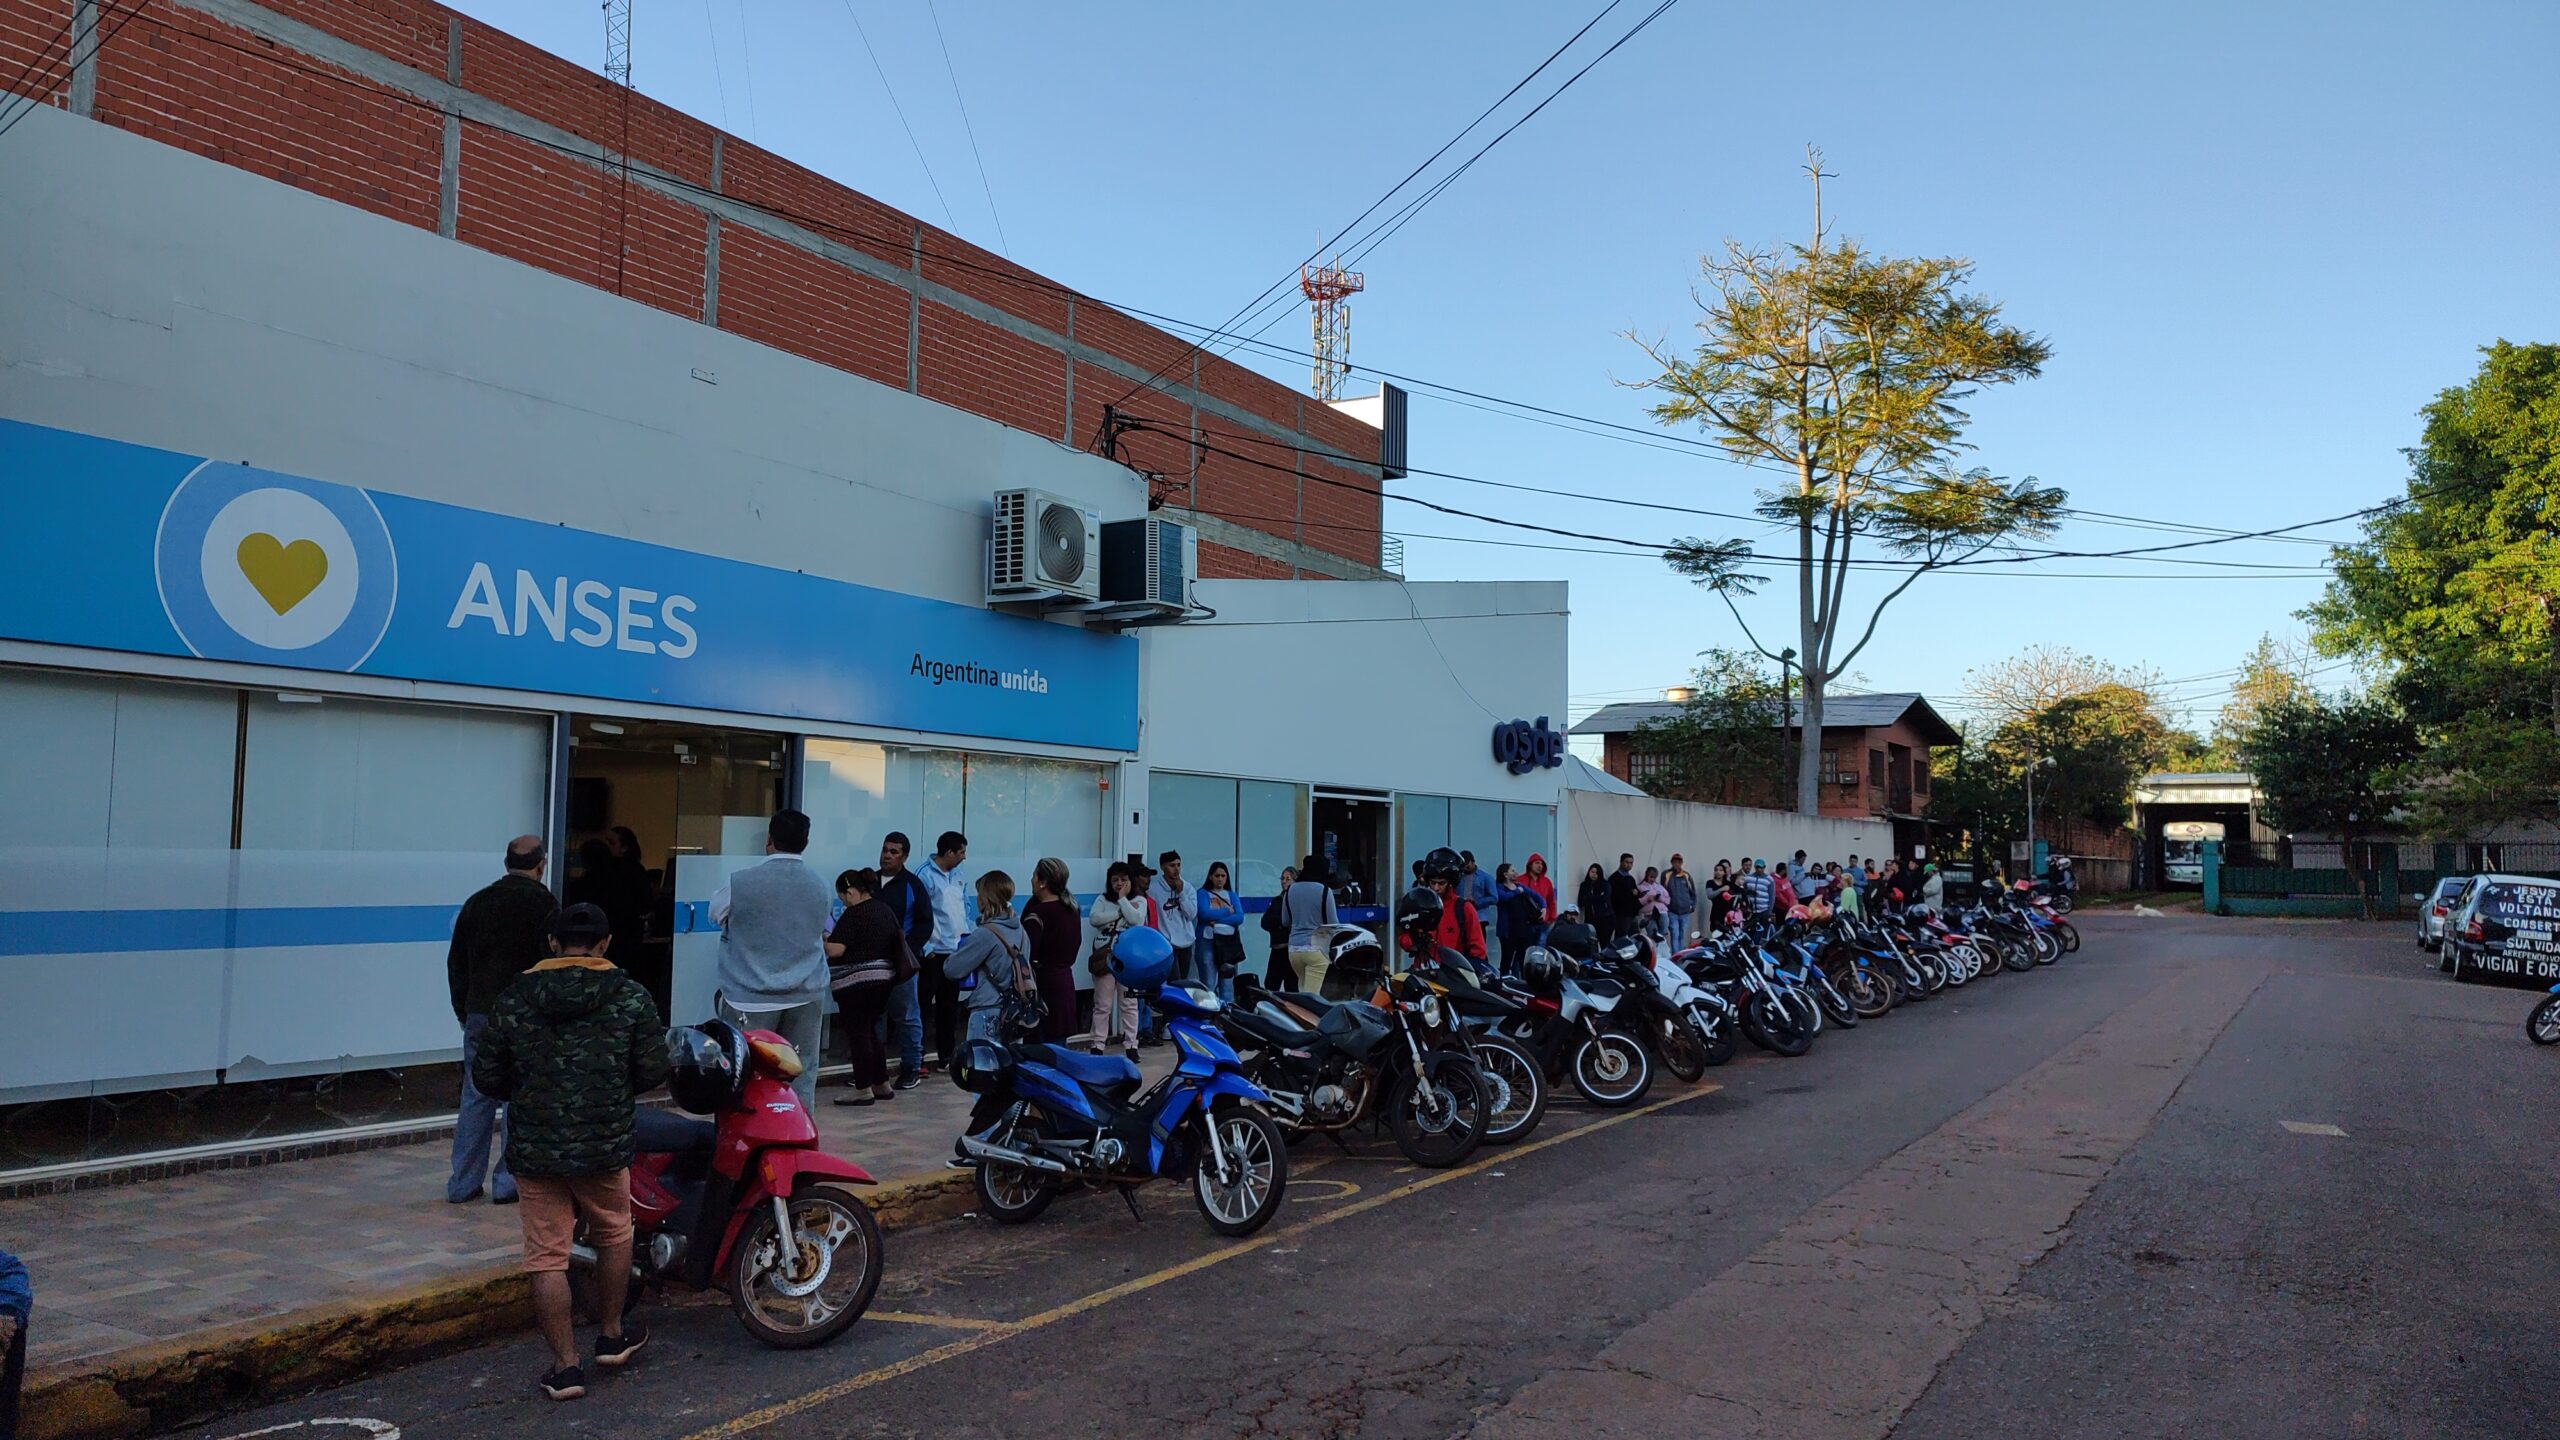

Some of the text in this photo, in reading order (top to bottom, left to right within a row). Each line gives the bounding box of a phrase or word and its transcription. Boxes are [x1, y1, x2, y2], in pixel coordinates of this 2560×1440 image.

[447, 561, 698, 659] ANSES
[910, 652, 1048, 694] Argentina unida
[1494, 716, 1564, 775] osde
[2513, 886, 2557, 898] JESUS
[2506, 938, 2531, 950] SUA
[2477, 955, 2560, 978] VIGIAI E OR
